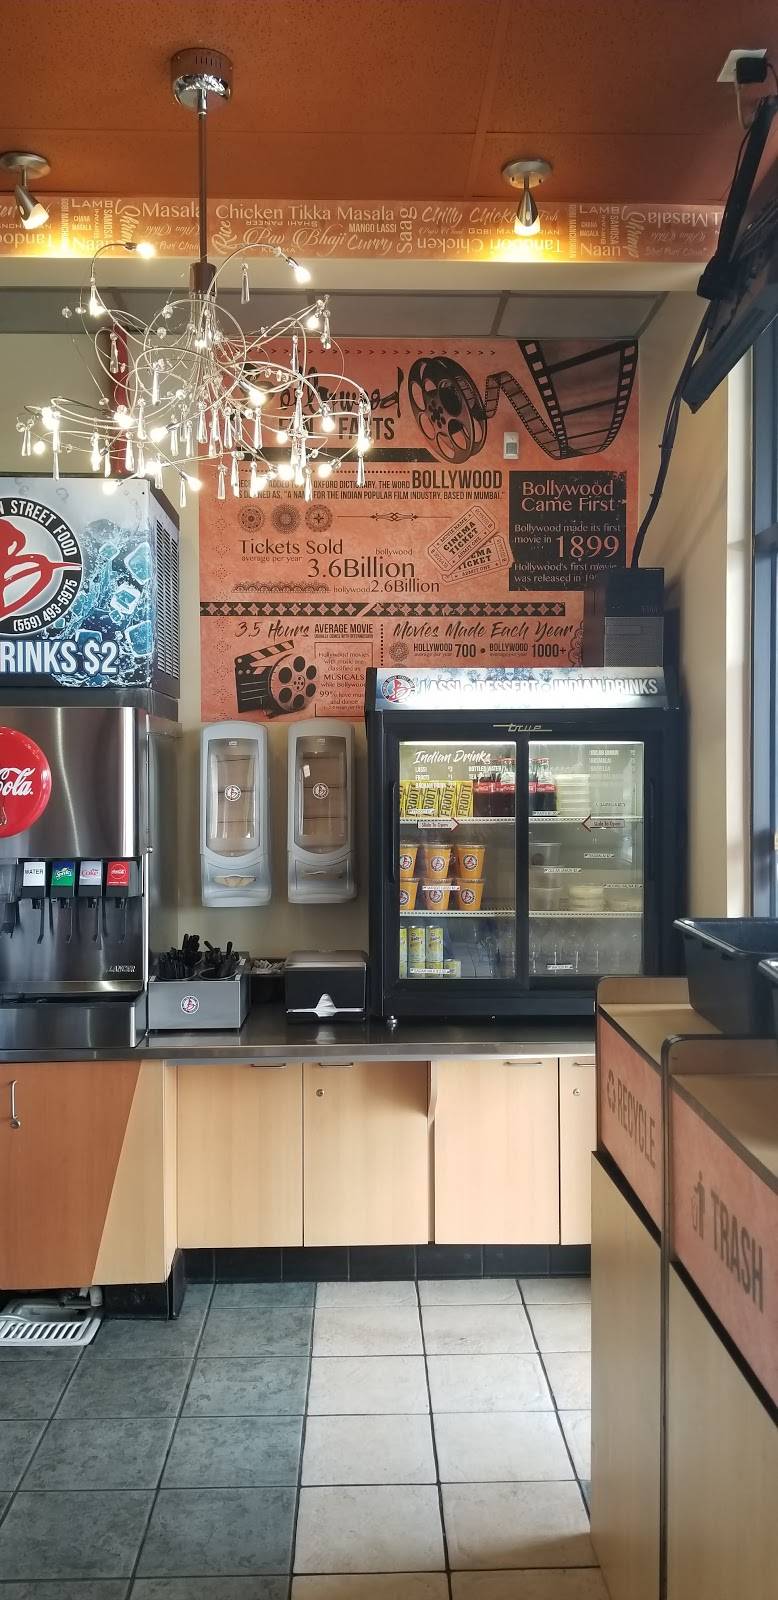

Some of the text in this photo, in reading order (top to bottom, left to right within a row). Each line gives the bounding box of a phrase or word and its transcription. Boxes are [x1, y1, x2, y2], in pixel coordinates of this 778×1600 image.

[72, 199, 113, 208] LAMB
[580, 205, 620, 214] LAMB
[115, 199, 141, 243] Shrim
[215, 204, 394, 223] Chicken Tikka Masala
[470, 207, 519, 226] Chicke
[349, 224, 396, 233] MANGO LASSI
[397, 207, 418, 253] Saag
[347, 234, 398, 255] Curry
[580, 243, 621, 257] Naan
[338, 417, 395, 441] FATS
[393, 481, 411, 489] WORD
[411, 470, 503, 489] BOLLYWOOD
[313, 491, 326, 499] FOR
[327, 491, 339, 499] THE
[341, 491, 363, 499] INDIAN
[364, 491, 392, 500] POPULAR
[394, 491, 408, 500] FILM
[444, 491, 464, 500] BASED
[466, 491, 473, 500] IN
[522, 479, 614, 500] Bollywood
[520, 496, 616, 512] Came First
[11, 500, 57, 527] STREET
[53, 524, 77, 557] FOOD
[443, 521, 477, 552] CINEMA
[514, 522, 621, 534] Bollywood made its first
[238, 538, 343, 555] Tickets Sold
[449, 528, 480, 556] TICKET
[514, 535, 620, 558] movie in 1899
[241, 556, 302, 564] average per year
[375, 548, 413, 560] bollywood
[514, 561, 568, 573] Hollywood's
[570, 561, 589, 571] first
[514, 575, 531, 583] was
[533, 574, 570, 583] released
[573, 574, 581, 582] in
[333, 584, 370, 594] hollywood
[13, 579, 78, 634] (559) 493-5975
[268, 619, 310, 641] Hours
[315, 623, 374, 634] AVERAGE MOVIE
[392, 621, 574, 640] Movies Made Each Year
[84, 639, 118, 676] $2
[413, 643, 453, 652] HOLLYWOOD
[455, 643, 477, 658] 700
[489, 643, 529, 652] BOLLYWOOD
[531, 643, 567, 657] 1000+
[324, 673, 366, 681] MUSICALS
[604, 676, 659, 697] DRINKS
[413, 749, 491, 765] Indian Drinks
[617, 1078, 656, 1169] RECYCLE
[711, 1189, 765, 1315] TRASH
